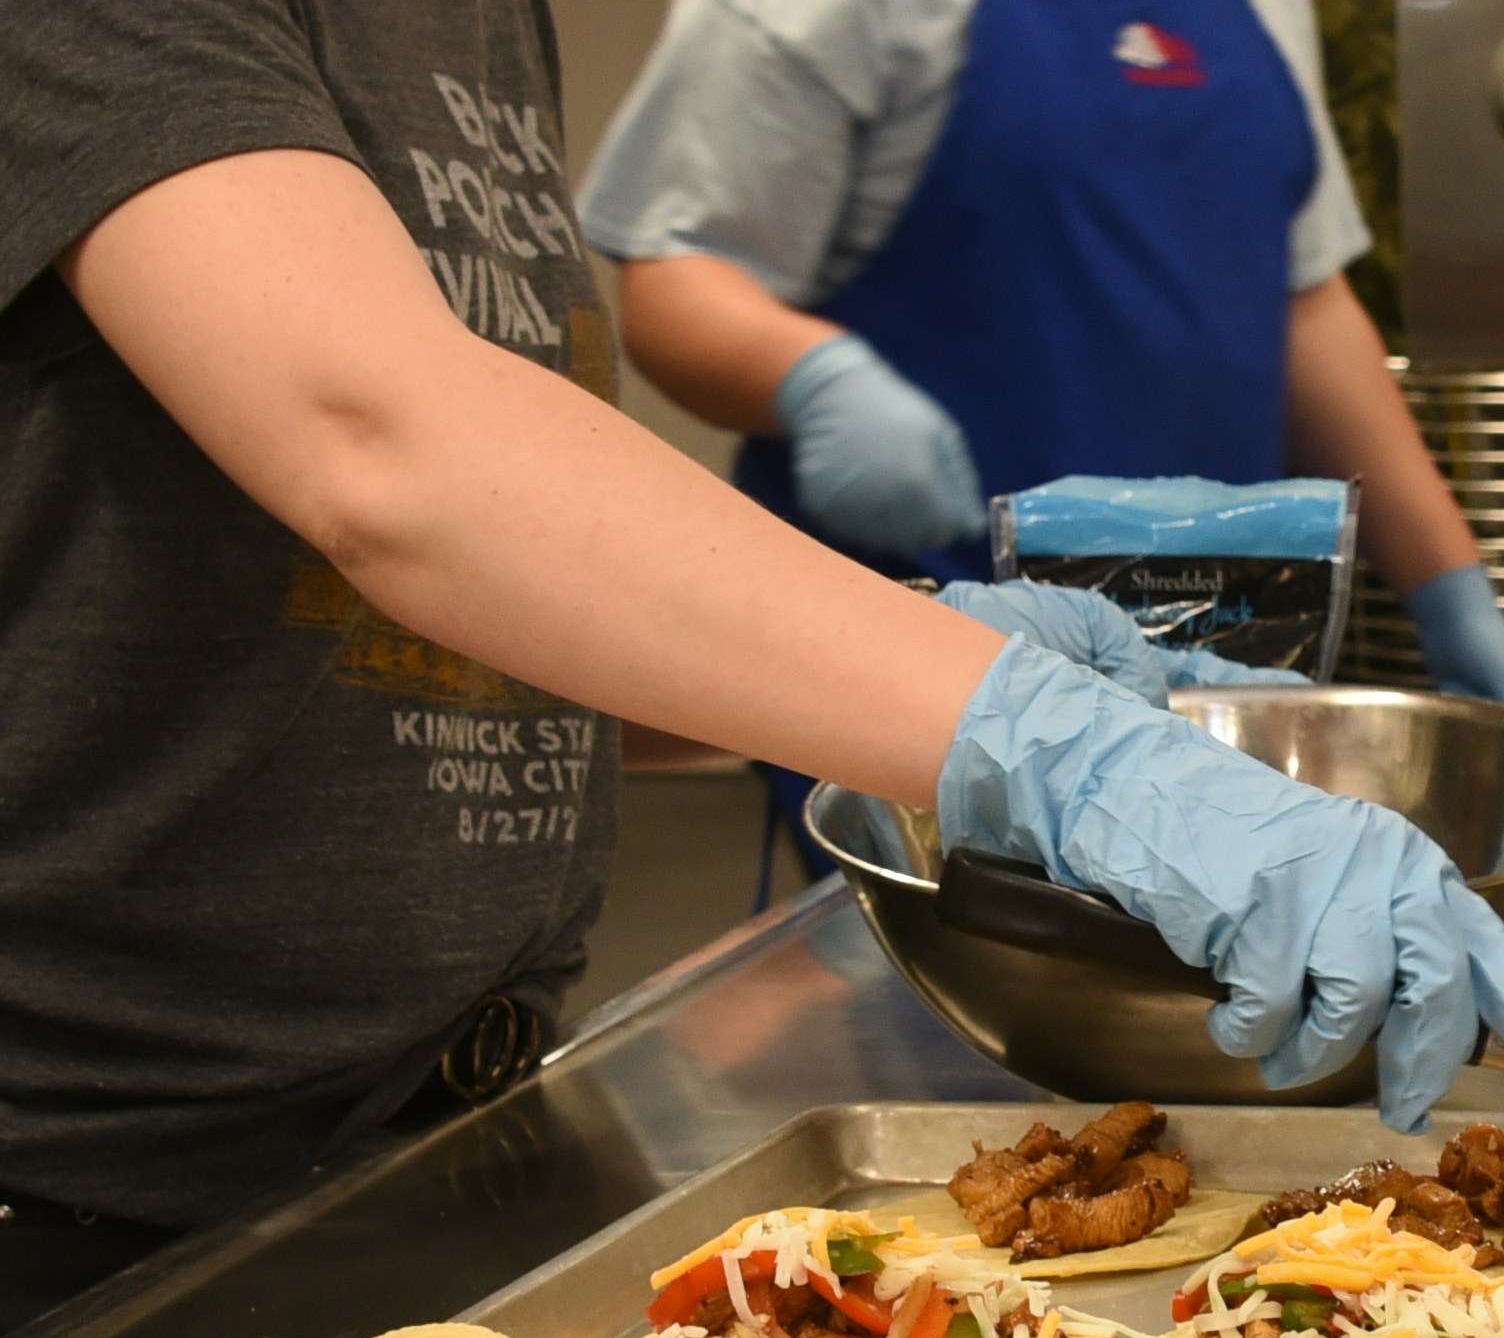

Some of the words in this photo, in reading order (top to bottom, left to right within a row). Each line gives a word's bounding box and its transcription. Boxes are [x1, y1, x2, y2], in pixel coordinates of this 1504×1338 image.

[432, 71, 561, 173] BCK
[1130, 567, 1225, 592] Shredded
[391, 710, 525, 755] KINNICK
[428, 758, 514, 797] IOWA
[523, 758, 588, 793] CIT
